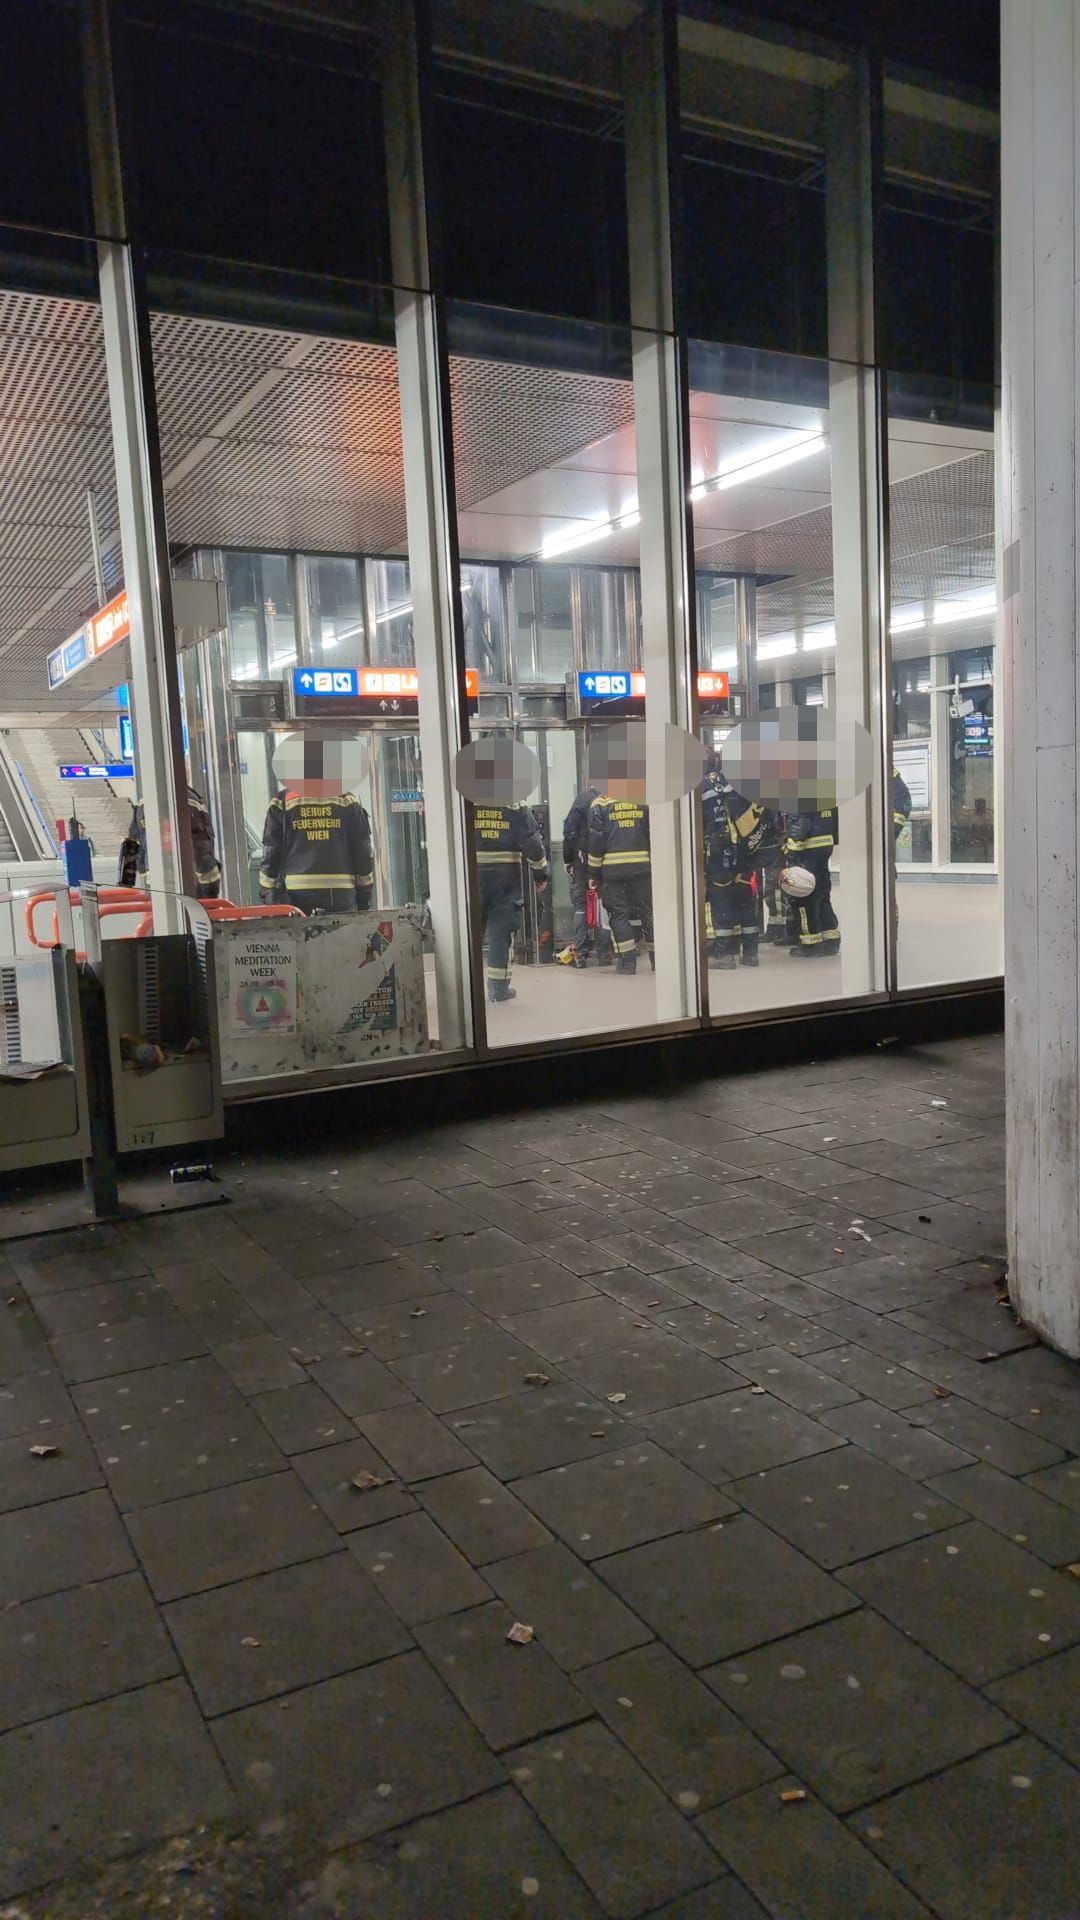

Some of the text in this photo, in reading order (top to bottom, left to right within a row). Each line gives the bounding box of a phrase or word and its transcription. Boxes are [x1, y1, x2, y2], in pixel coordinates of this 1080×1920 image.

[301, 807, 332, 817] BERUFS
[476, 810, 502, 819] BERUFS
[293, 818, 341, 830] FEUERWEHR
[474, 820, 509, 829] EUERWEHR
[618, 820, 634, 828] WIEN
[306, 830, 329, 840] WIEN
[481, 830, 499, 838] WIEN
[246, 944, 280, 953] VIENNA
[235, 956, 292, 966] MEDITATION
[250, 968, 276, 976] WEEK
